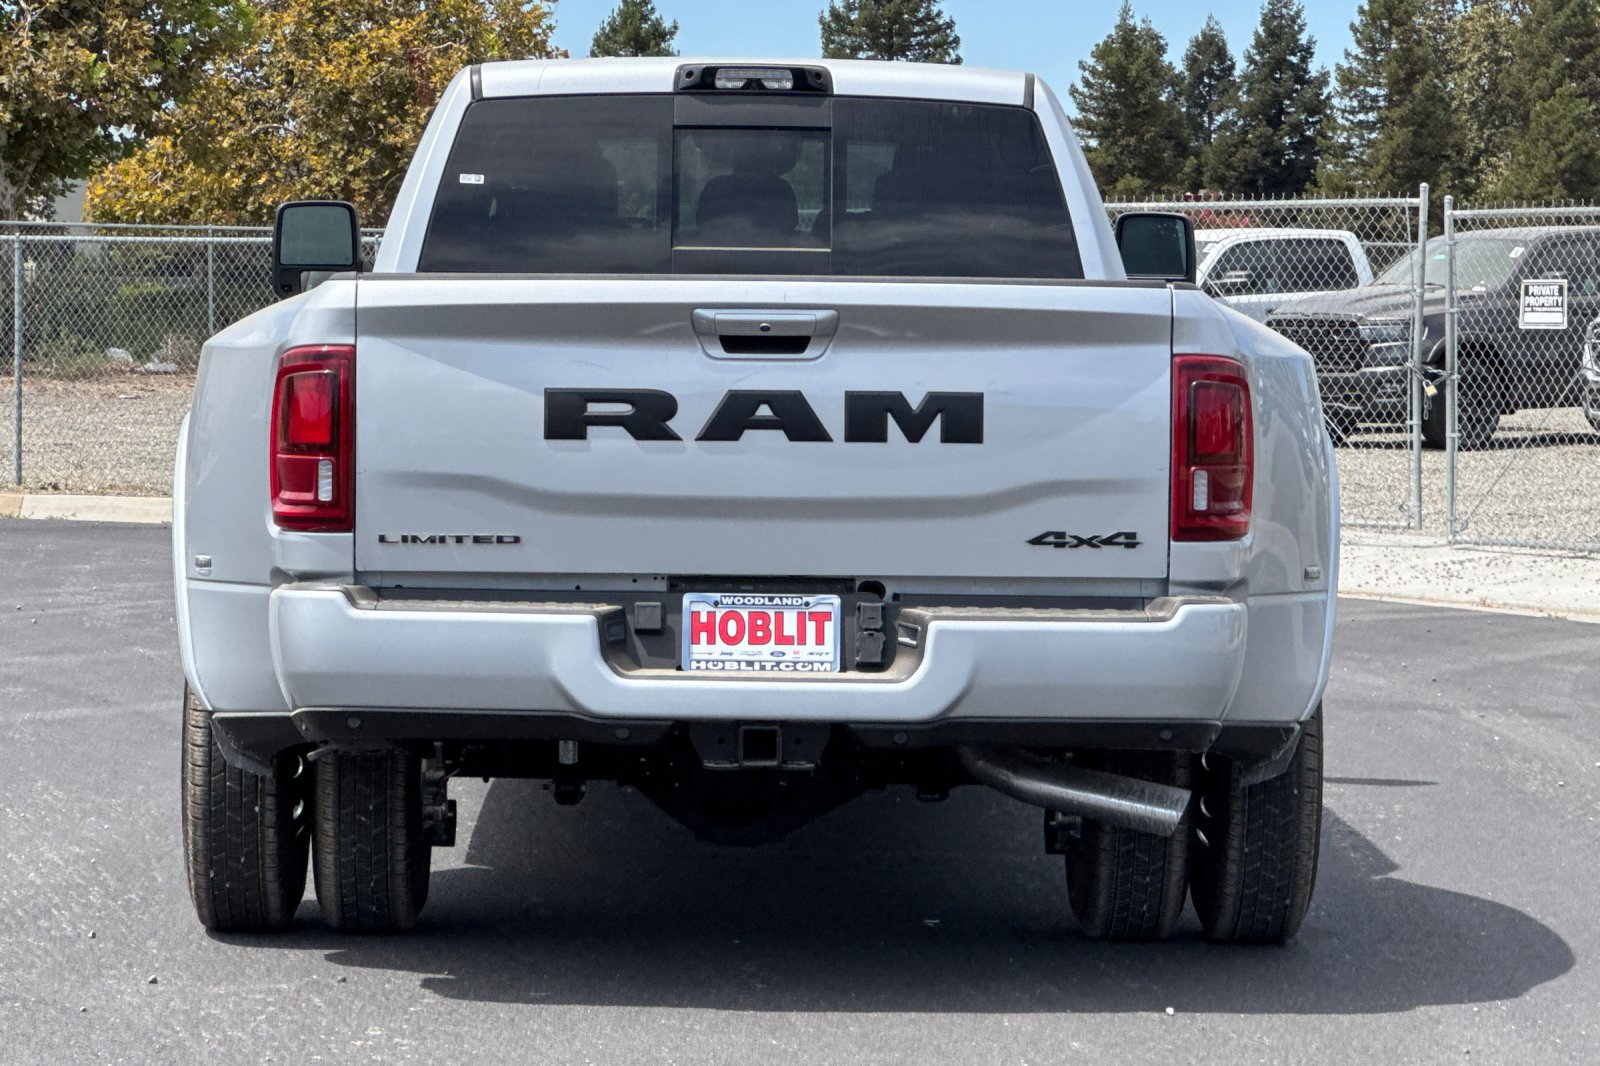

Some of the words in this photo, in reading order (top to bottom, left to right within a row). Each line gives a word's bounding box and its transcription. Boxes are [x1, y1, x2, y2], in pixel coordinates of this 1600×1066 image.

[1529, 285, 1559, 296] PRIVATE
[1525, 296, 1562, 307] PROPERTY
[544, 388, 984, 443] RAM
[378, 534, 521, 544] LIMITED
[1025, 531, 1143, 549] 4x4
[721, 596, 802, 606] WOODLAND
[691, 610, 832, 646] HOBLIT
[690, 661, 831, 671] HOBLIT.COM
